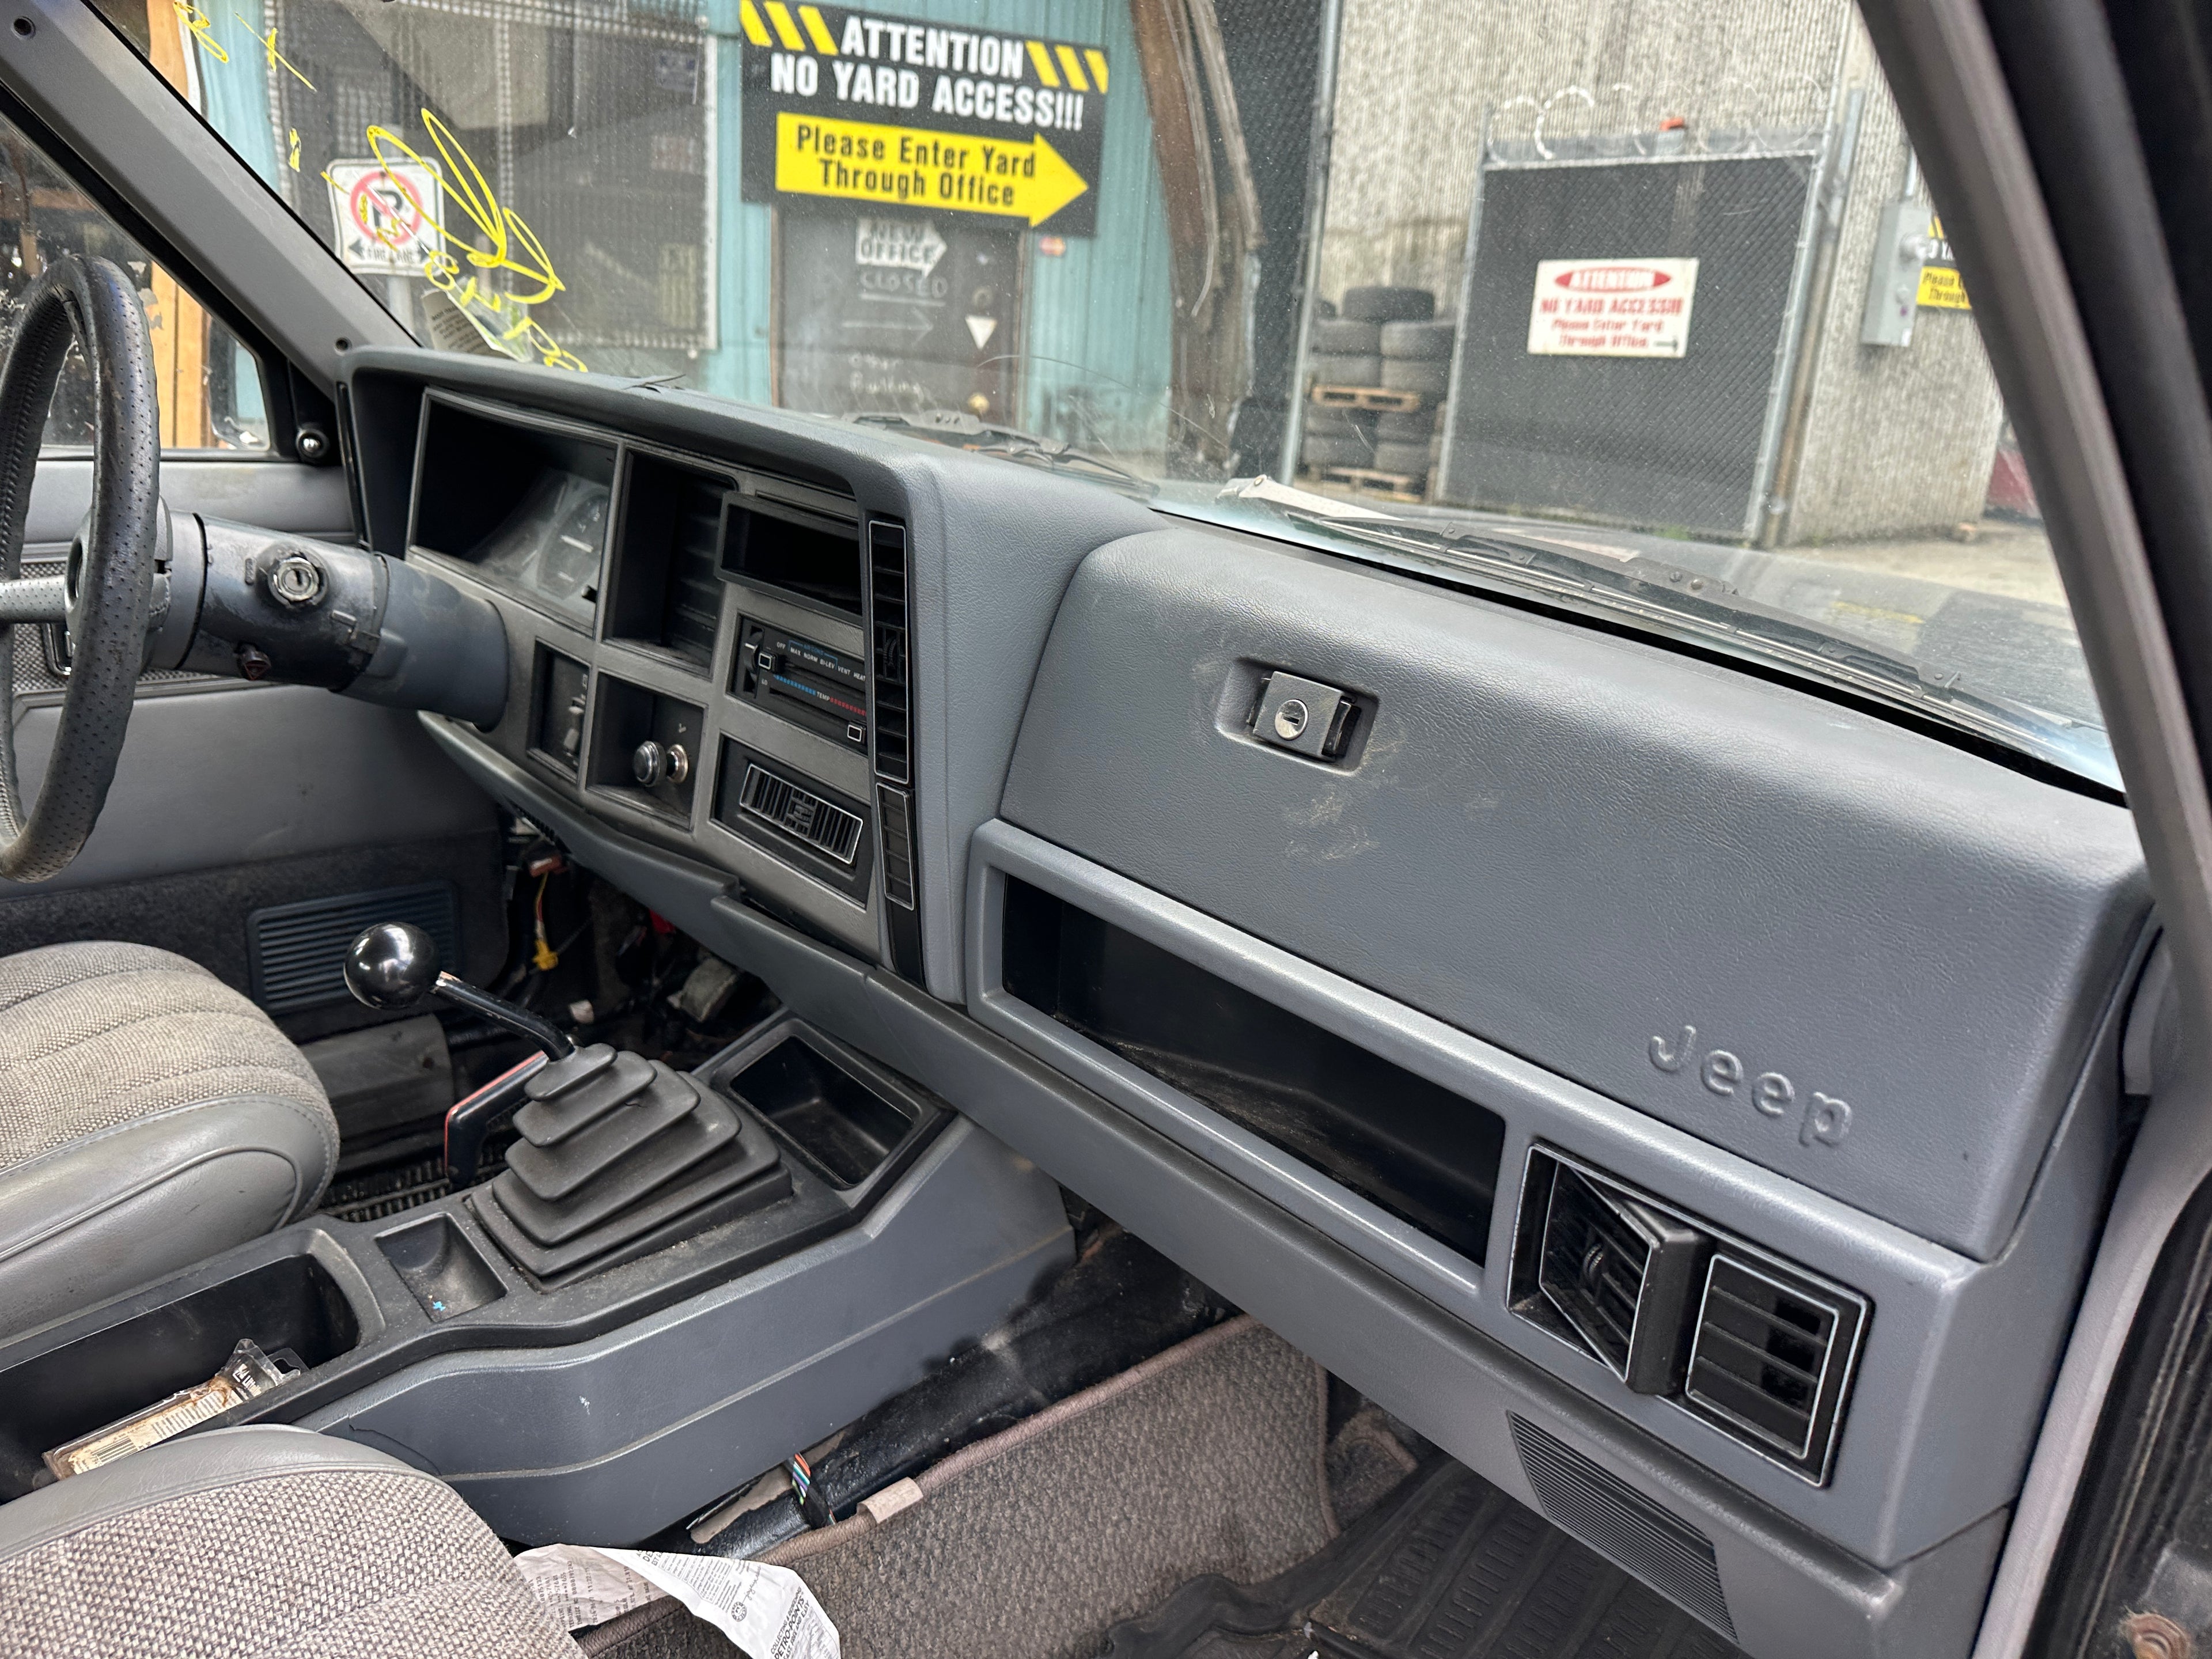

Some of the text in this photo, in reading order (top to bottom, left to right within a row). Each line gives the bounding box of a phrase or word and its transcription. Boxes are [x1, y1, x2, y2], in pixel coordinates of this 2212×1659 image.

[840, 15, 1024, 79] ATTENTION
[771, 52, 1084, 131] NO YARD ACCESS!!!
[797, 124, 1036, 177] Please Enter Yard
[819, 158, 1014, 206] Through Office
[861, 271, 949, 298] CLOSED
[1540, 298, 1559, 314] NO
[777, 642, 786, 650] OFF
[790, 647, 866, 682] MAX NORM BI-LEV VENT HEAT
[816, 691, 830, 701] TEMP
[1648, 1025, 1853, 1148] Jeep
[801, 1600, 810, 1618] EASY
[770, 1620, 788, 1653] COLLECTING
[774, 1596, 805, 1659] PETRO-POINTS
